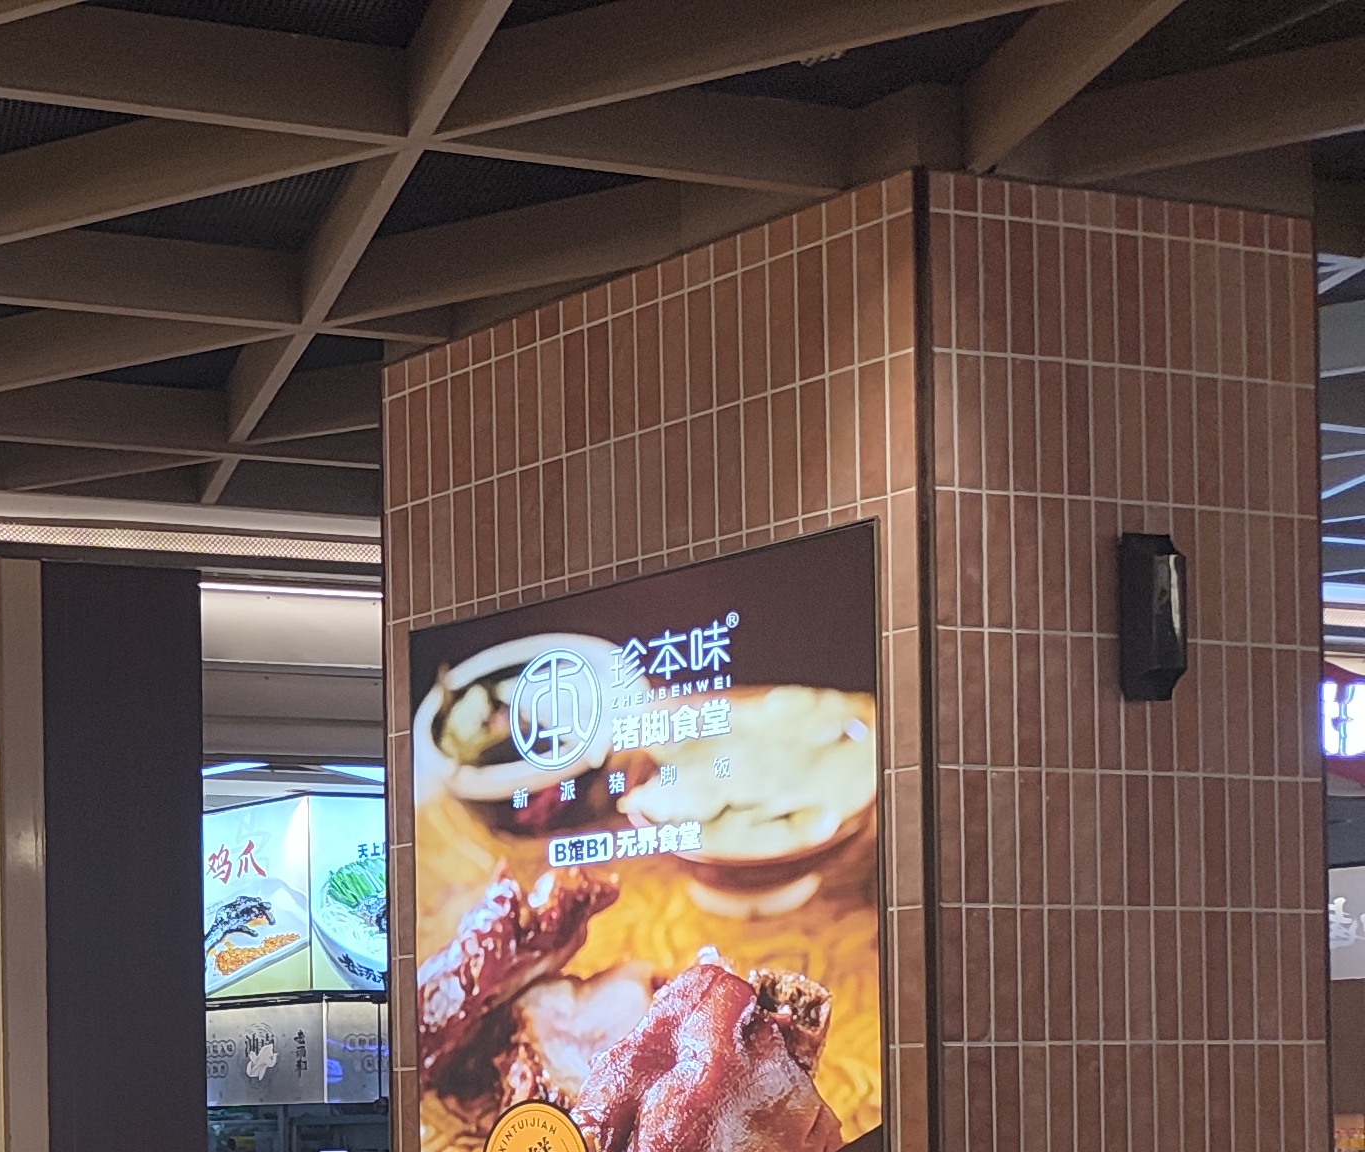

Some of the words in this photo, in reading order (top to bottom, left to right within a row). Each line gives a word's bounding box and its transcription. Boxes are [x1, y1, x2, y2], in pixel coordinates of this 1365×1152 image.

[610, 620, 733, 690] 珍本味
[610, 675, 732, 709] ZHENBENWEI
[611, 699, 733, 752] 猪脚食堂
[512, 756, 732, 809] 新派猪脚饭
[206, 840, 267, 884] 鸡爪
[553, 838, 611, 865] B馆B1
[616, 821, 703, 859] 无界食堂
